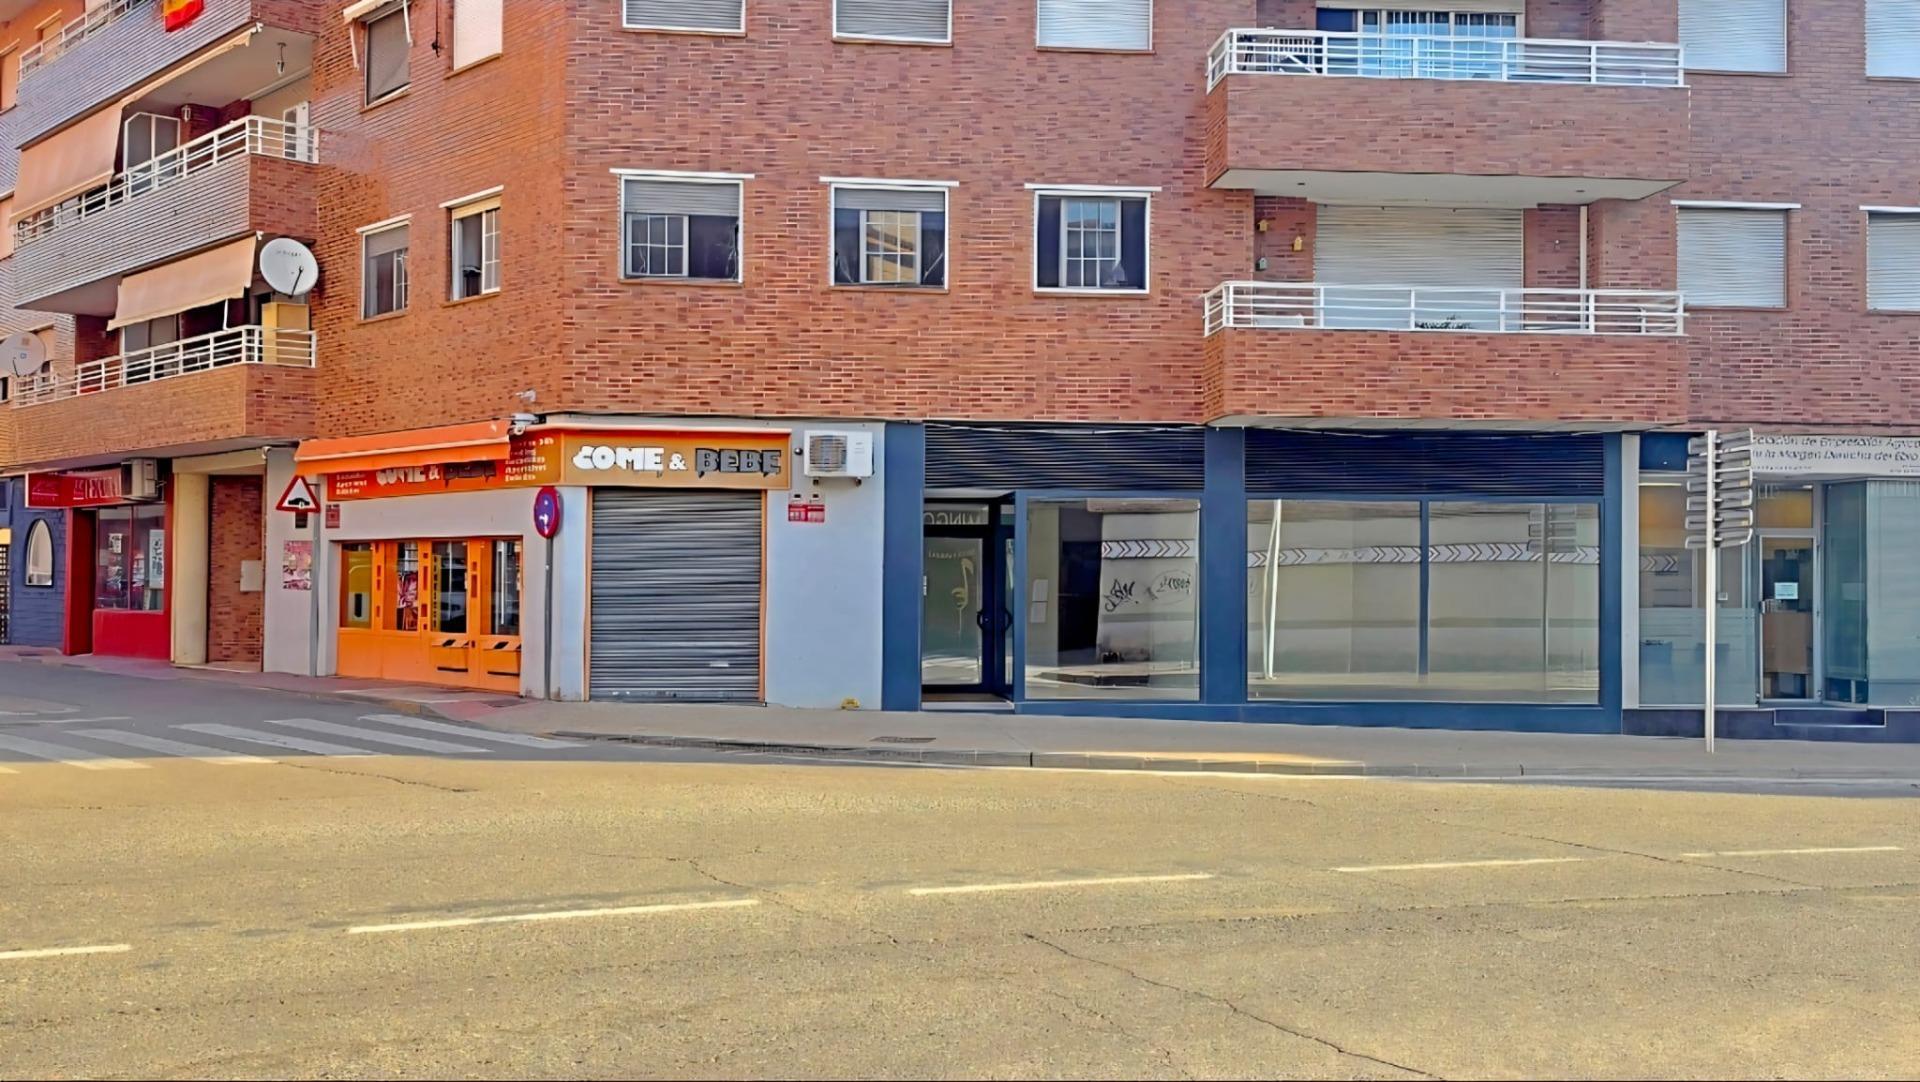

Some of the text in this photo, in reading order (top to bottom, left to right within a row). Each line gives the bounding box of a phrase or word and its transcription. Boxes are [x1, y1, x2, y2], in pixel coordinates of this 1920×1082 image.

[572, 445, 781, 478] COME & BEBE
